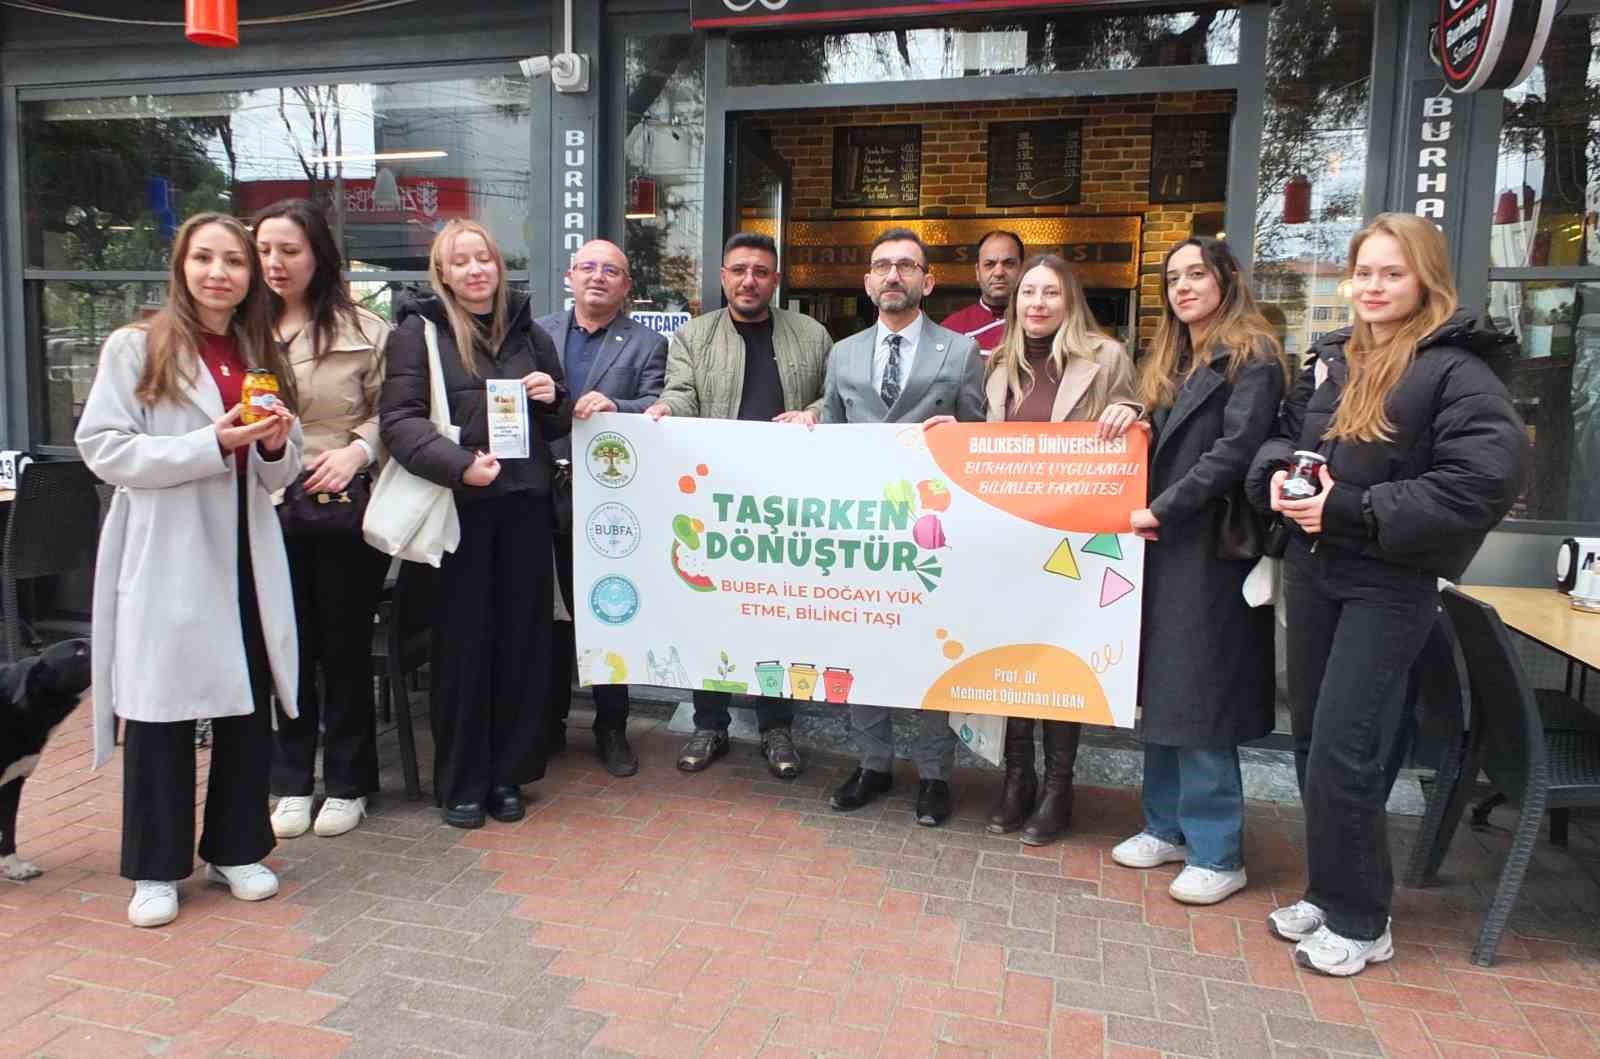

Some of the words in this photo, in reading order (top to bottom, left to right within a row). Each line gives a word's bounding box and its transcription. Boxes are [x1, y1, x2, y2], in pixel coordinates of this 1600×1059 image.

[1415, 96, 1453, 232] BURHA
[712, 492, 910, 535] TAŞIRKEN
[595, 525, 633, 536] BUBFA
[706, 528, 918, 577] DÖNÜŞTÜR
[721, 580, 778, 597] BUBFA
[783, 581, 808, 599] İLE
[813, 583, 881, 602] DOĞAYI
[886, 588, 923, 605] YÜK
[741, 603, 791, 621] ETME,
[796, 605, 857, 624] BİLİNCİ
[863, 611, 901, 629] TAŞI
[951, 685, 996, 702] Mehmet
